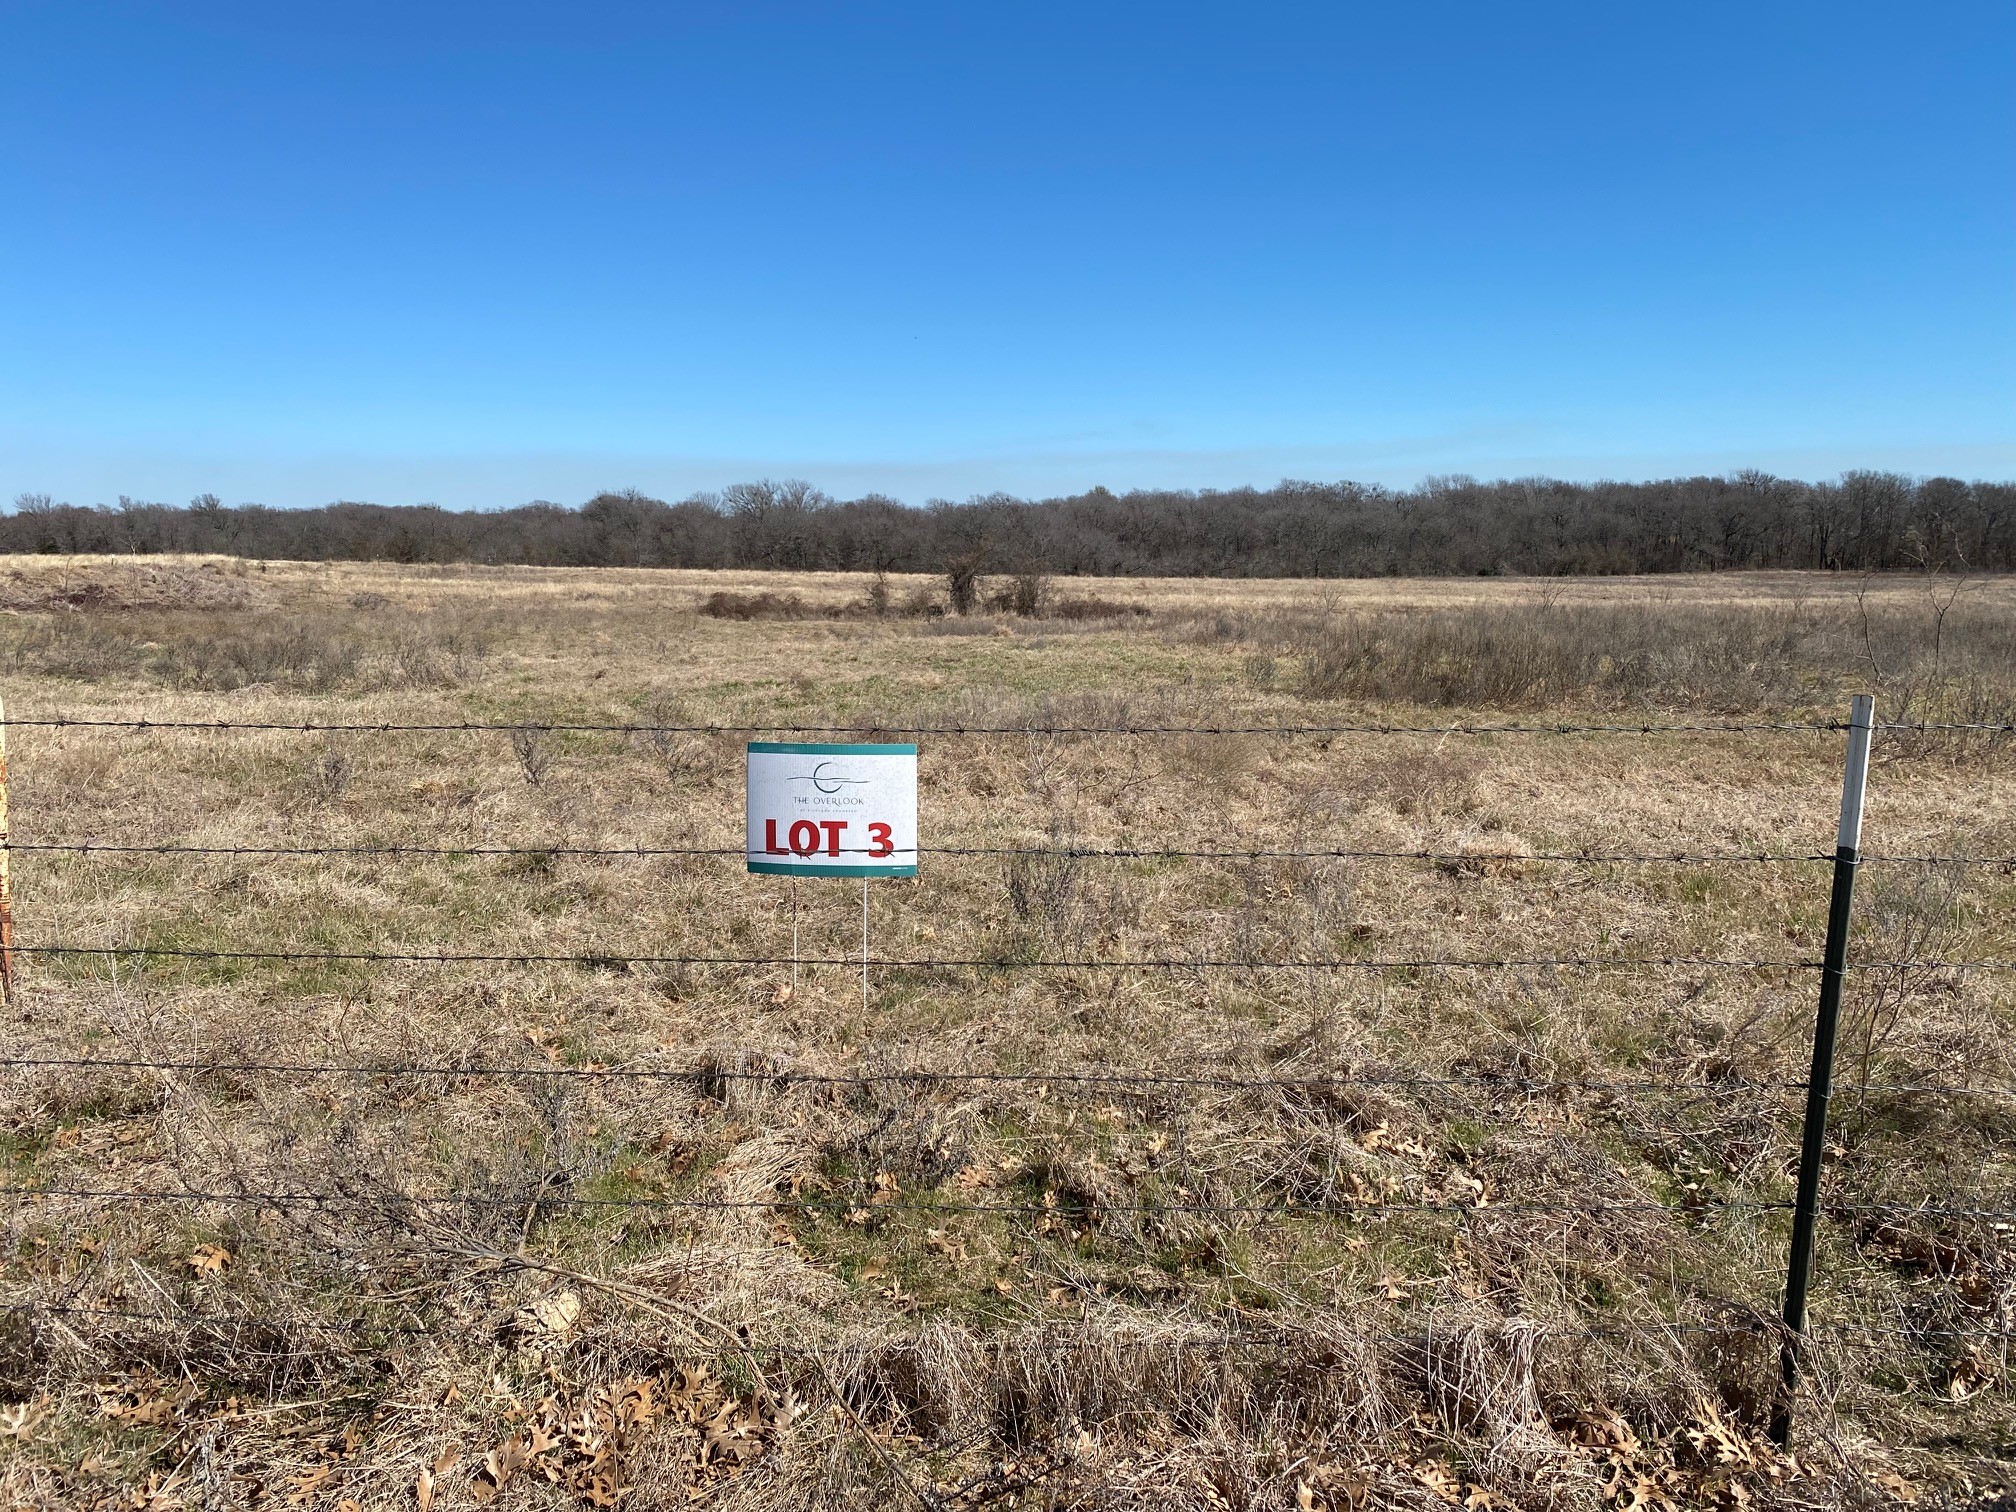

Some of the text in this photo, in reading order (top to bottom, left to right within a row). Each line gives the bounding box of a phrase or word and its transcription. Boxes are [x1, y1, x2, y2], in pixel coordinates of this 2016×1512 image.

[793, 796, 864, 807] THE OVERLOOK
[765, 819, 895, 858] LOT 3
